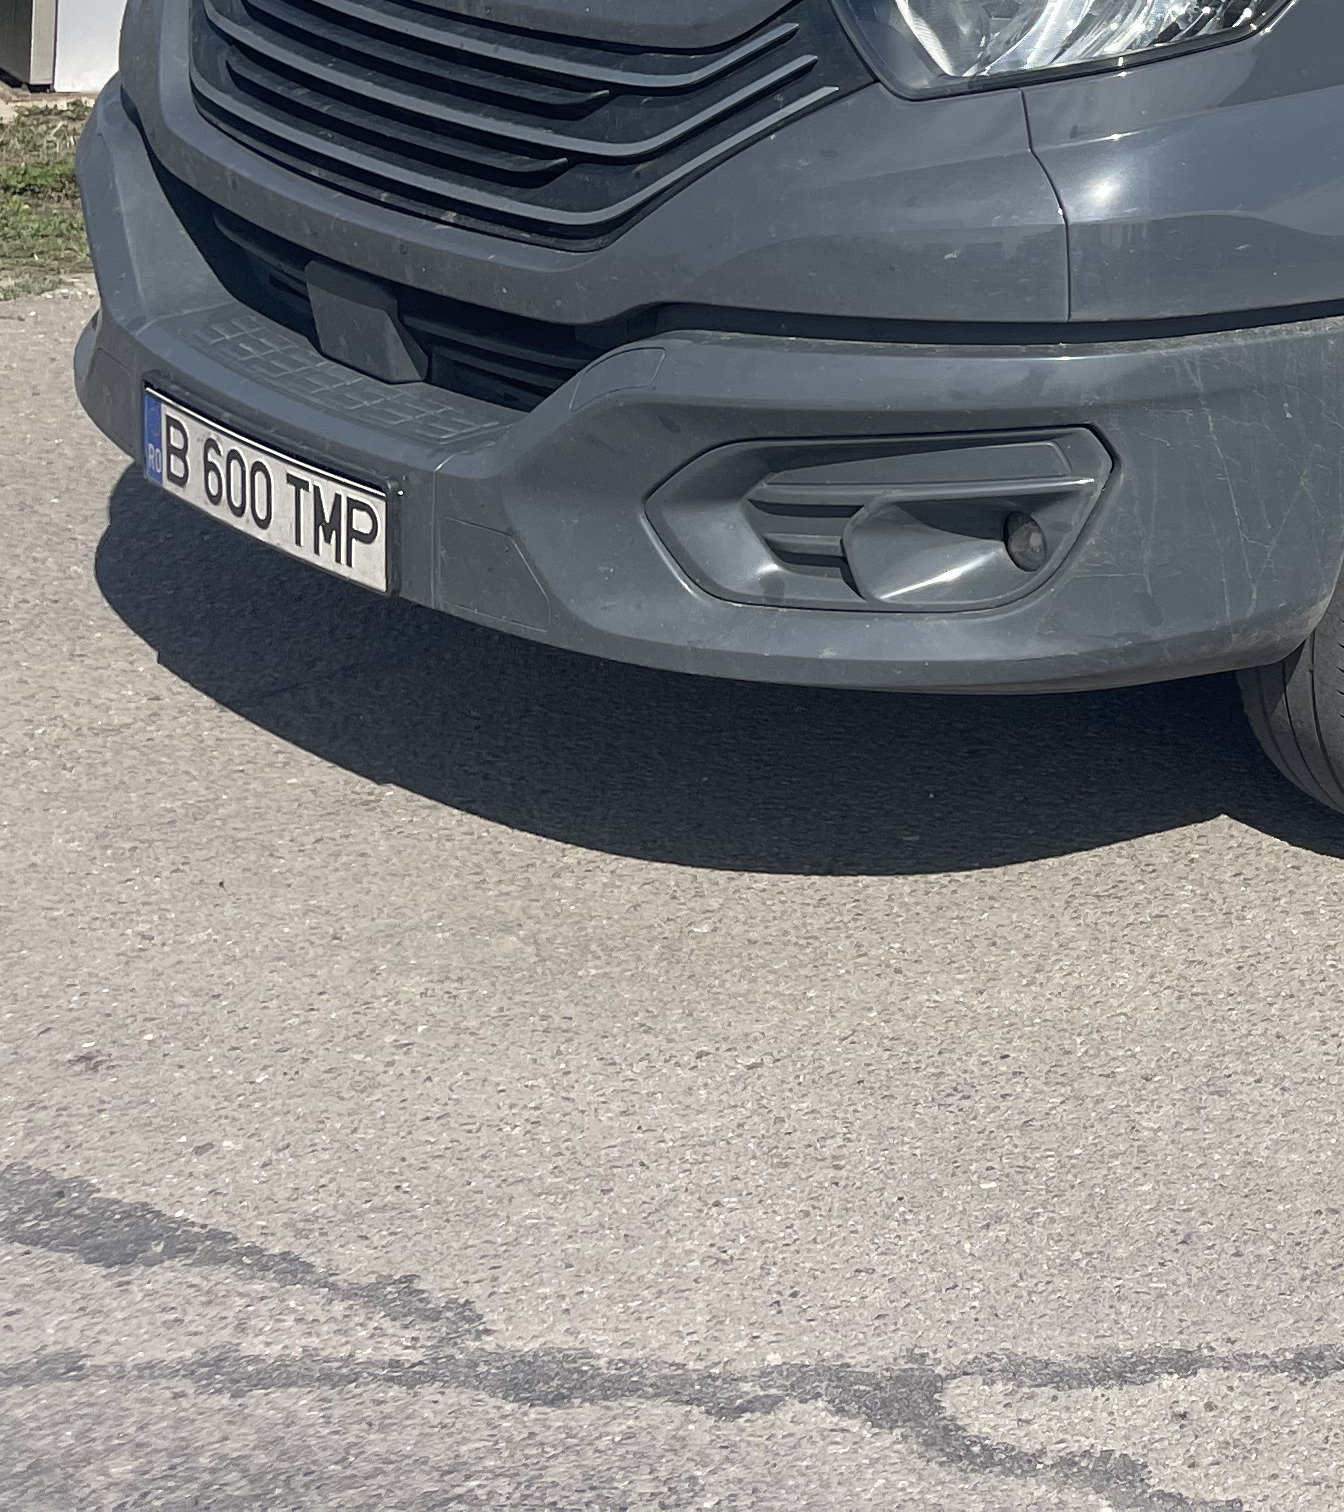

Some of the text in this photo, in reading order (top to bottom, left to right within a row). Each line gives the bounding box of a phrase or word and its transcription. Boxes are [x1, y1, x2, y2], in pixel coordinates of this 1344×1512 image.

[165, 414, 379, 568] B 600 TMP
